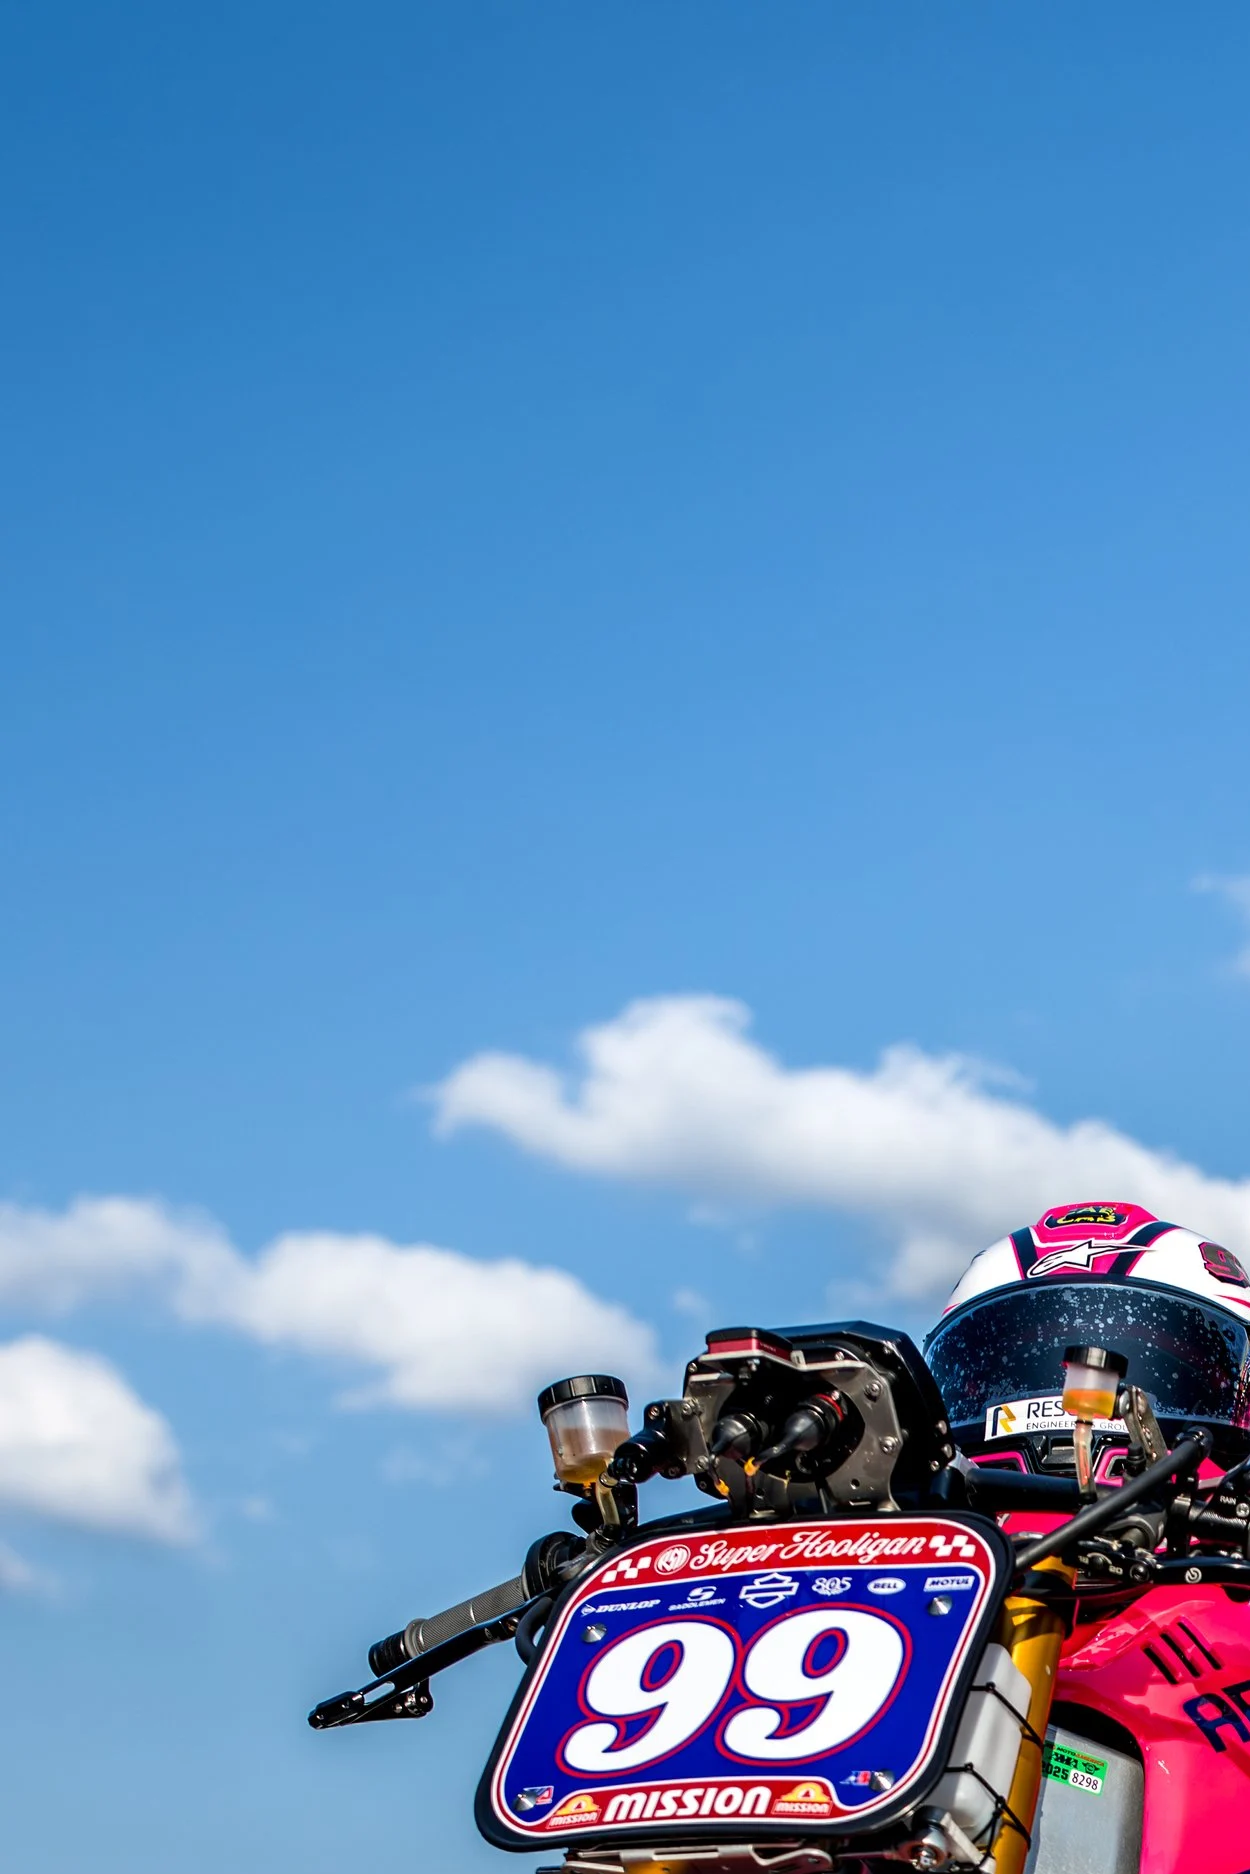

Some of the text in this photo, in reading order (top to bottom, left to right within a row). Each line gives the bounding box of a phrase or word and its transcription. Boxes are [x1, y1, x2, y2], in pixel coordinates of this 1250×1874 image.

[1100, 1422, 1127, 1432] GROU
[1219, 1495, 1237, 1506] RAIN
[690, 1540, 783, 1571] Super
[780, 1531, 927, 1565] Hooligan
[595, 1599, 661, 1613] DUNLOP
[872, 1581, 898, 1591] BELL
[928, 1578, 971, 1589] MOTUL
[558, 1605, 910, 1776] 99
[1071, 1772, 1099, 1790] 8298
[550, 1786, 830, 1826] MISSION MISSION MISSION
